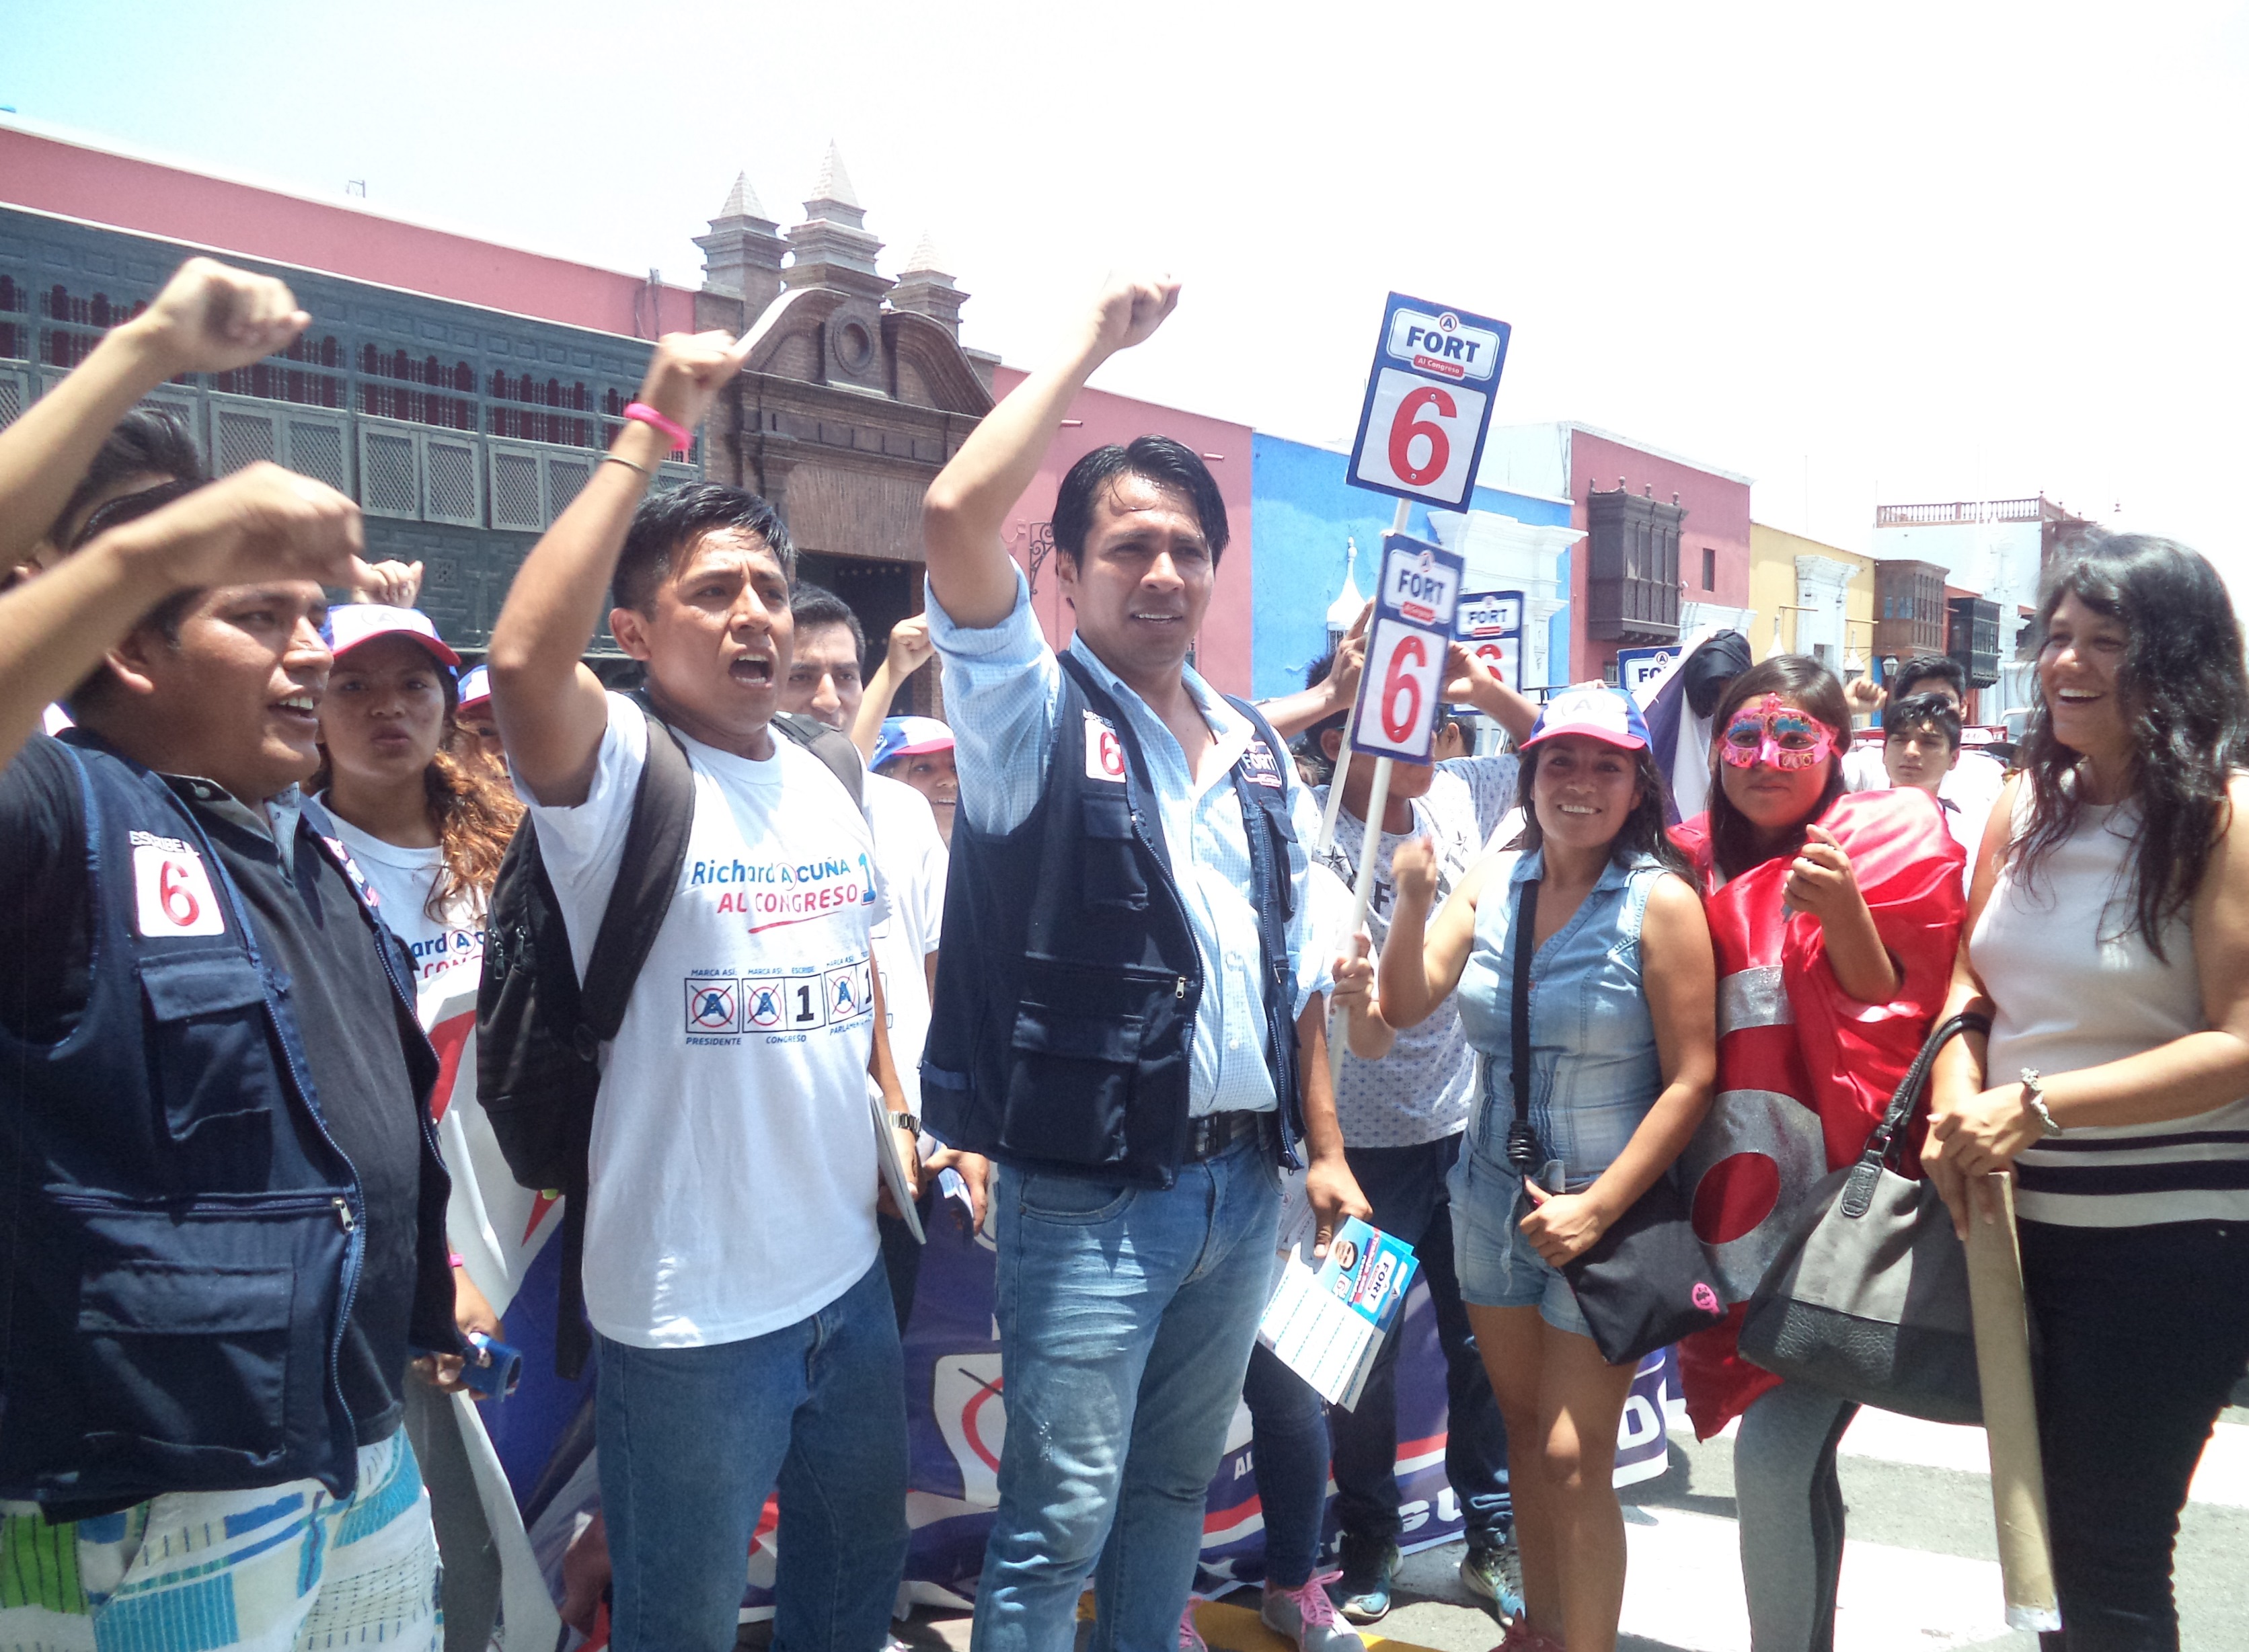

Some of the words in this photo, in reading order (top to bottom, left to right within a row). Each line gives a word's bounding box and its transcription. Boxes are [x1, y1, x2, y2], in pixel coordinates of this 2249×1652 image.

[1406, 326, 1480, 363] FORT
[1427, 360, 1459, 374] Congreso
[1388, 386, 1457, 485] 6
[1398, 569, 1445, 605] FORT
[1468, 608, 1508, 624] FORT
[1638, 666, 1667, 682] FO
[1381, 635, 1427, 744] 6
[1100, 732, 1124, 775] 6
[1242, 753, 1276, 771] FORT
[691, 859, 775, 885] Richard
[160, 861, 200, 927] 6
[717, 893, 747, 913] AL
[755, 884, 857, 913] CONGRESO
[410, 933, 447, 958] ard
[796, 985, 814, 1022] 1
[686, 1036, 742, 1046] PRESIDENTE
[766, 1034, 806, 1044] CONGRESO
[1337, 1280, 1346, 1292] 6
[1370, 1262, 1389, 1301] FORT
